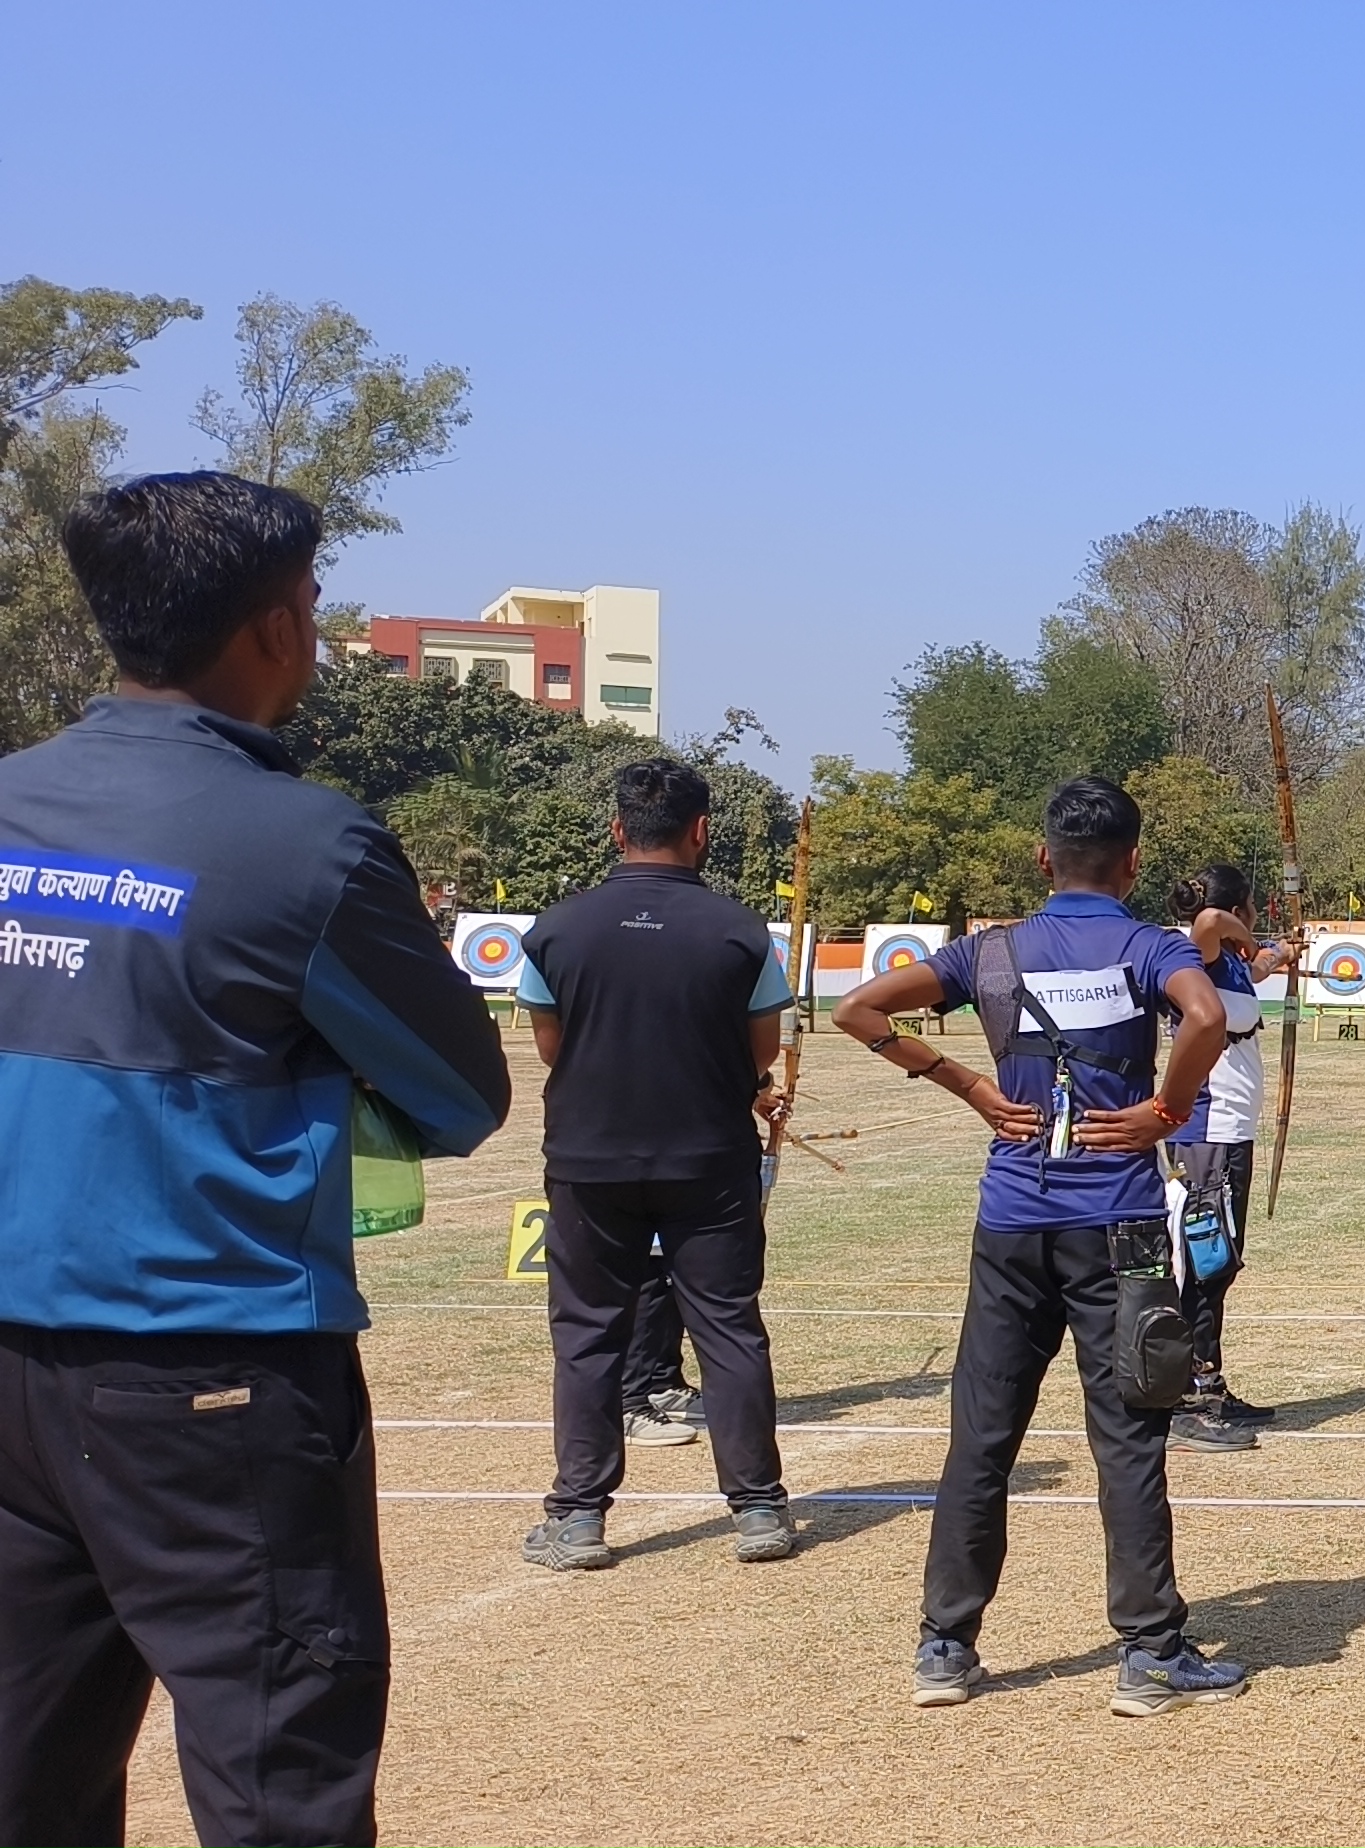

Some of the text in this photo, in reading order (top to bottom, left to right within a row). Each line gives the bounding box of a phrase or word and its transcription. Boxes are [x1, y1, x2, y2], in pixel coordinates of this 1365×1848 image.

[37, 867, 112, 903] कल्याण
[111, 869, 185, 916] विभाग
[1035, 984, 1119, 1004] ATTISGARH
[1340, 1026, 1357, 1040] 28
